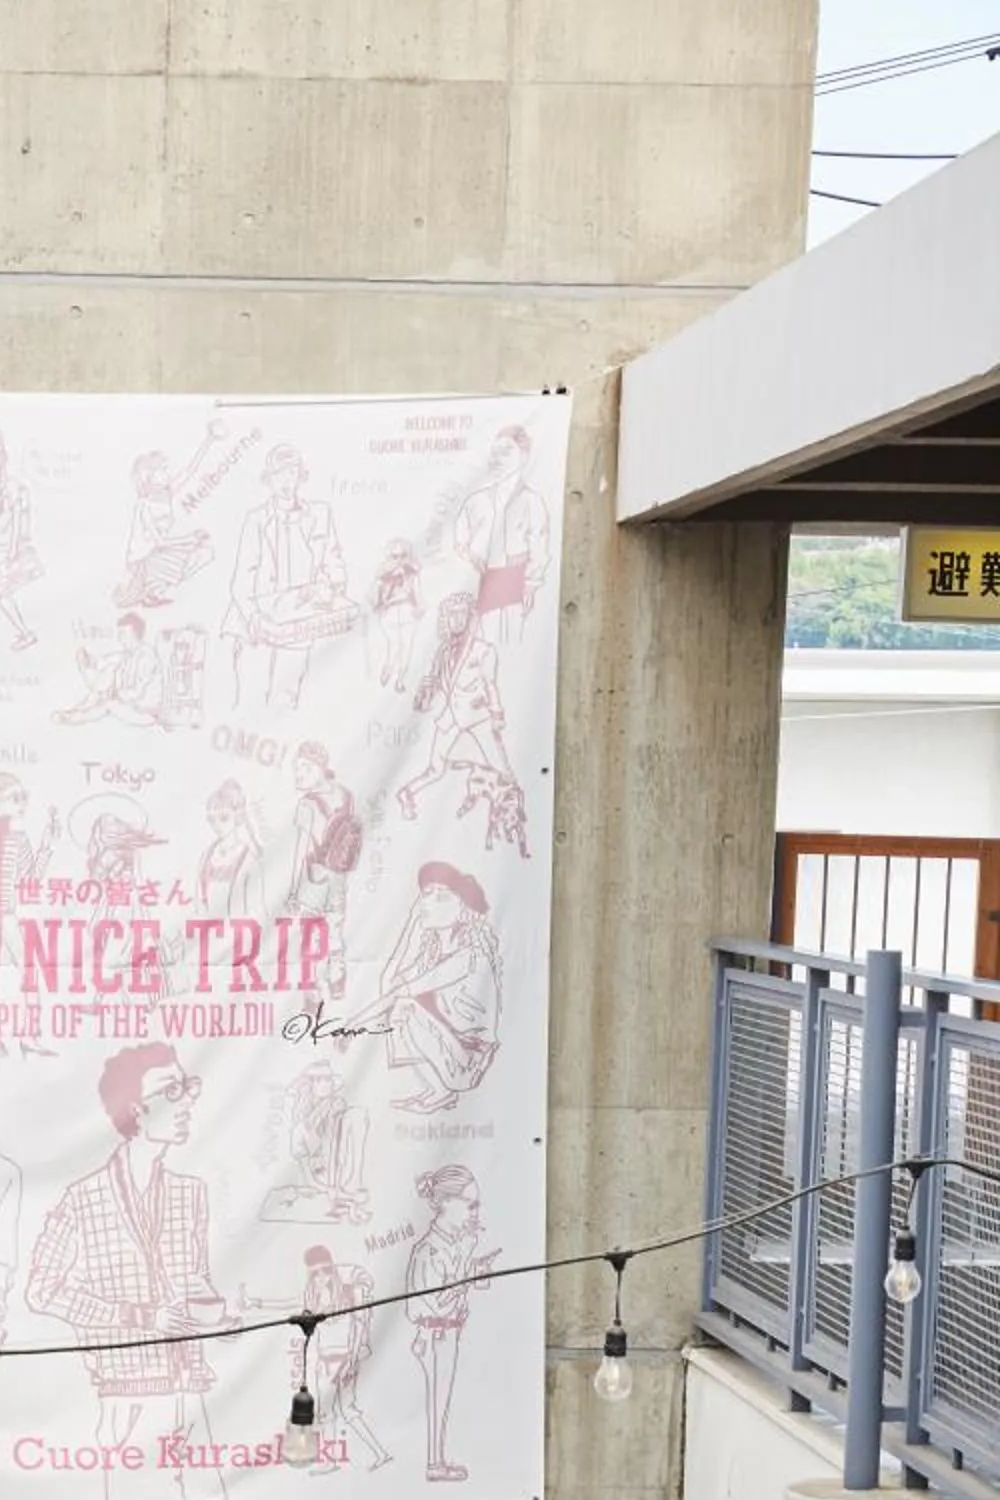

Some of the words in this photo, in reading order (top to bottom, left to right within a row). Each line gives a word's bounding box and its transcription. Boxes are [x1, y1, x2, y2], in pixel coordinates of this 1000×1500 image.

[181, 427, 263, 513] Melbourne
[210, 724, 289, 770] OMG!
[80, 761, 156, 795] Tokyo
[19, 918, 163, 994] NICE
[186, 915, 330, 994] TRIP
[52, 1003, 84, 1039] OF
[98, 1003, 150, 1039] THE
[364, 1222, 416, 1252] Madrid
[12, 1436, 146, 1471] Cuore
[155, 1429, 351, 1470] Kuraski
